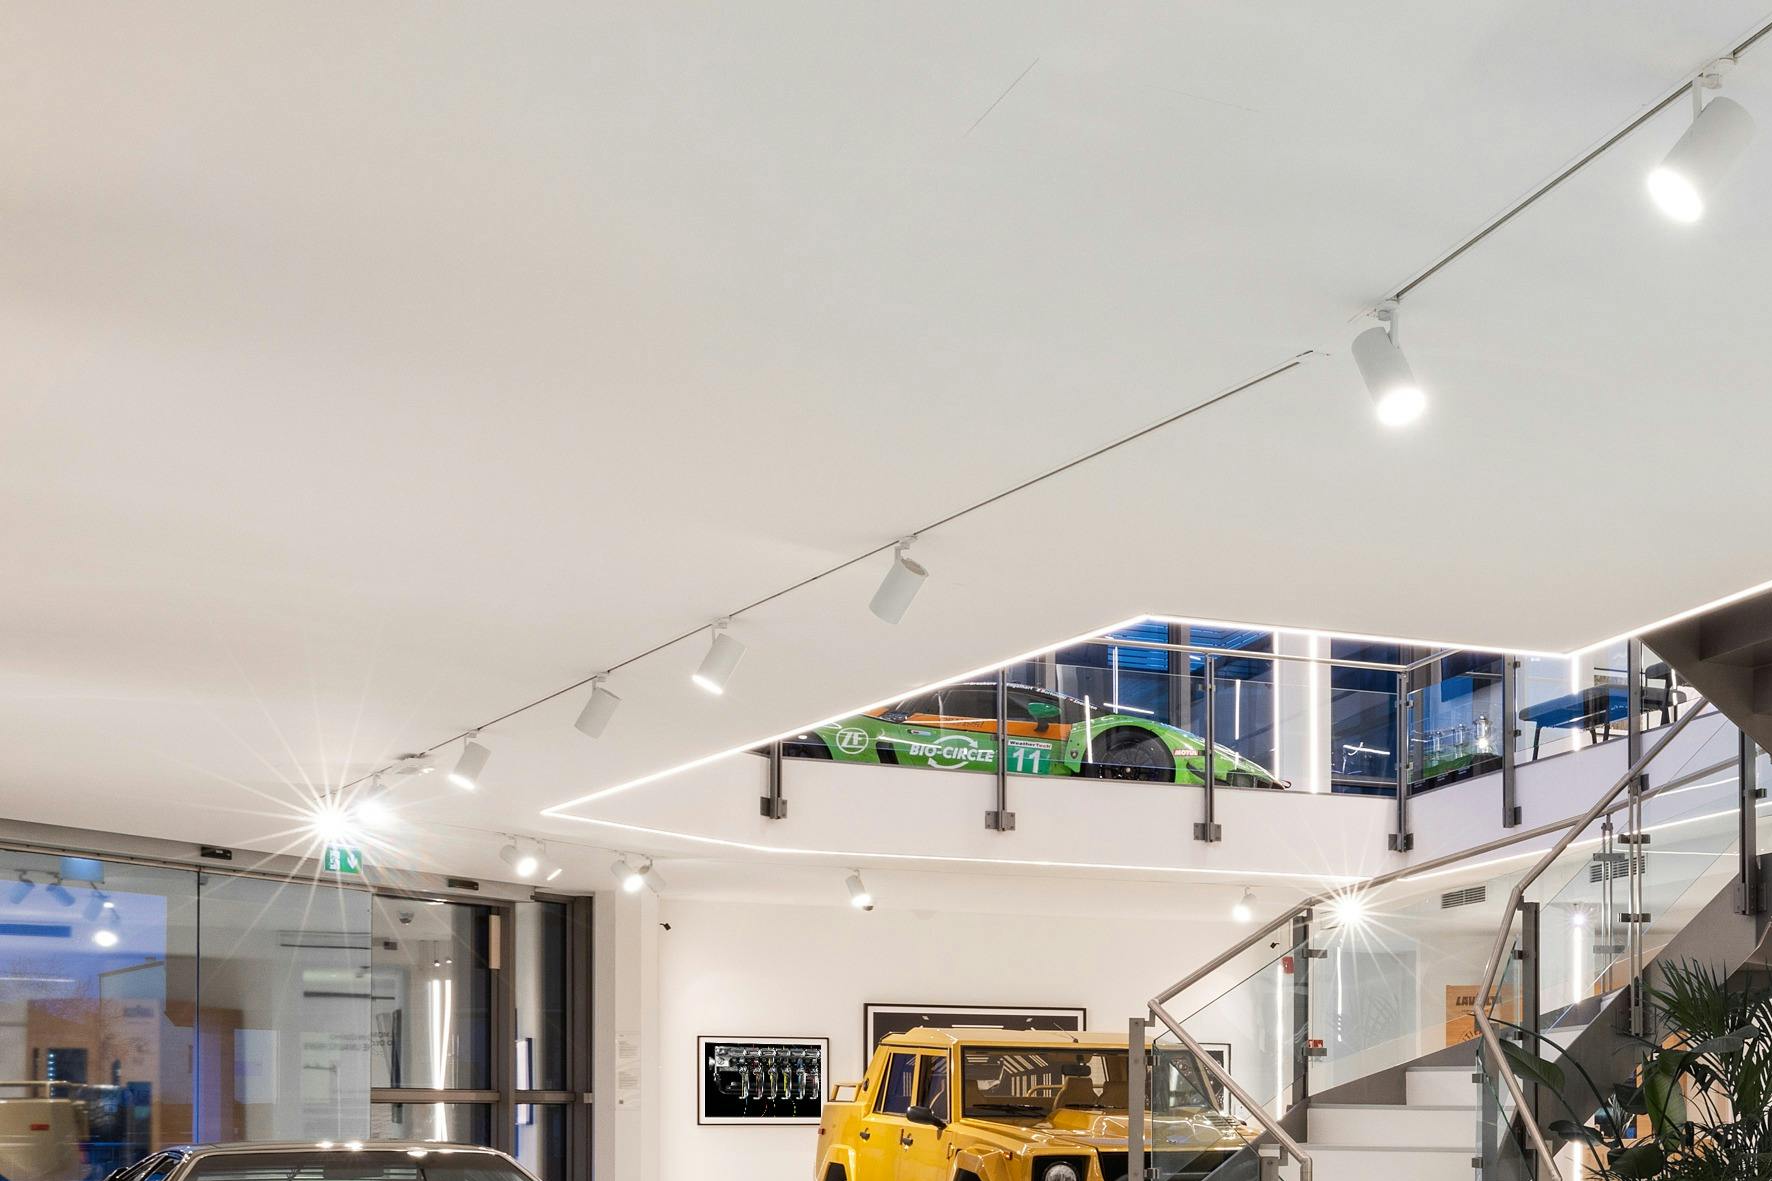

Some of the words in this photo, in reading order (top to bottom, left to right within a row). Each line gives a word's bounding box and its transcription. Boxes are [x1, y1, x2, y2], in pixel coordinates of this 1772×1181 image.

[840, 731, 863, 748] ZF
[1009, 740, 1051, 749] WeatherTech
[909, 743, 997, 763] BIO-CIRCLE
[1012, 748, 1041, 774] 11
